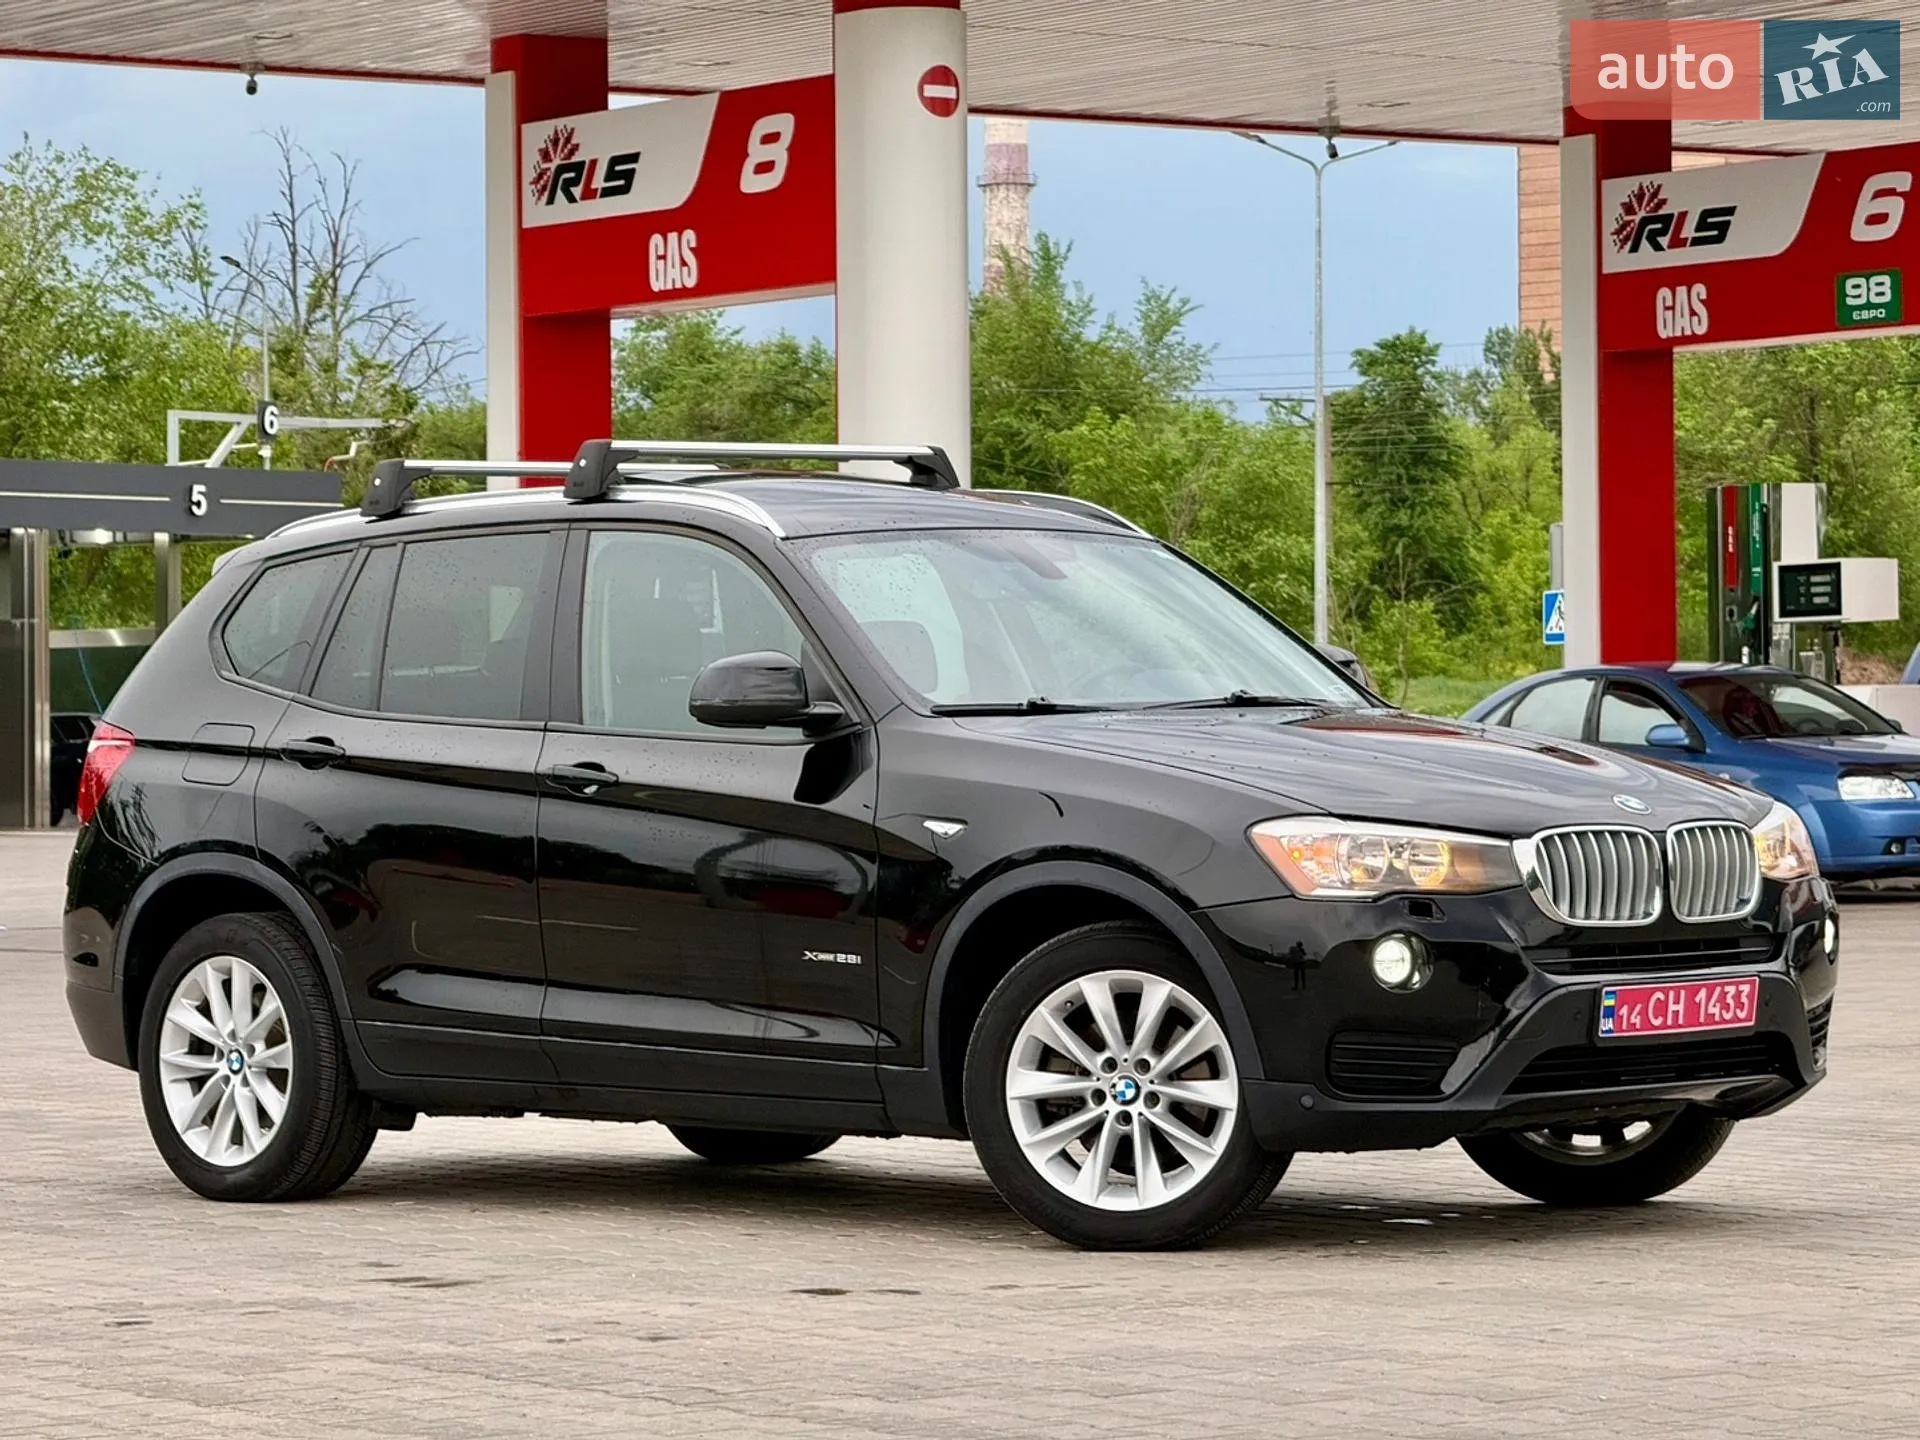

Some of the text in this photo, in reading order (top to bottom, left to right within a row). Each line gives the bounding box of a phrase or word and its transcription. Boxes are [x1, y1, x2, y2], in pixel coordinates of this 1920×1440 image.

[740, 112, 795, 195] 8
[545, 151, 641, 206] RLS
[1628, 205, 1738, 254] RLS
[1849, 170, 1913, 243] 6
[648, 228, 699, 293] GAS
[1655, 282, 1710, 340] GAS
[1845, 274, 1892, 306] 98
[263, 405, 280, 436] 6
[190, 483, 208, 517] 5
[1602, 1017, 1614, 1031] UA
[1618, 983, 1751, 1030] 14 CH 1433
